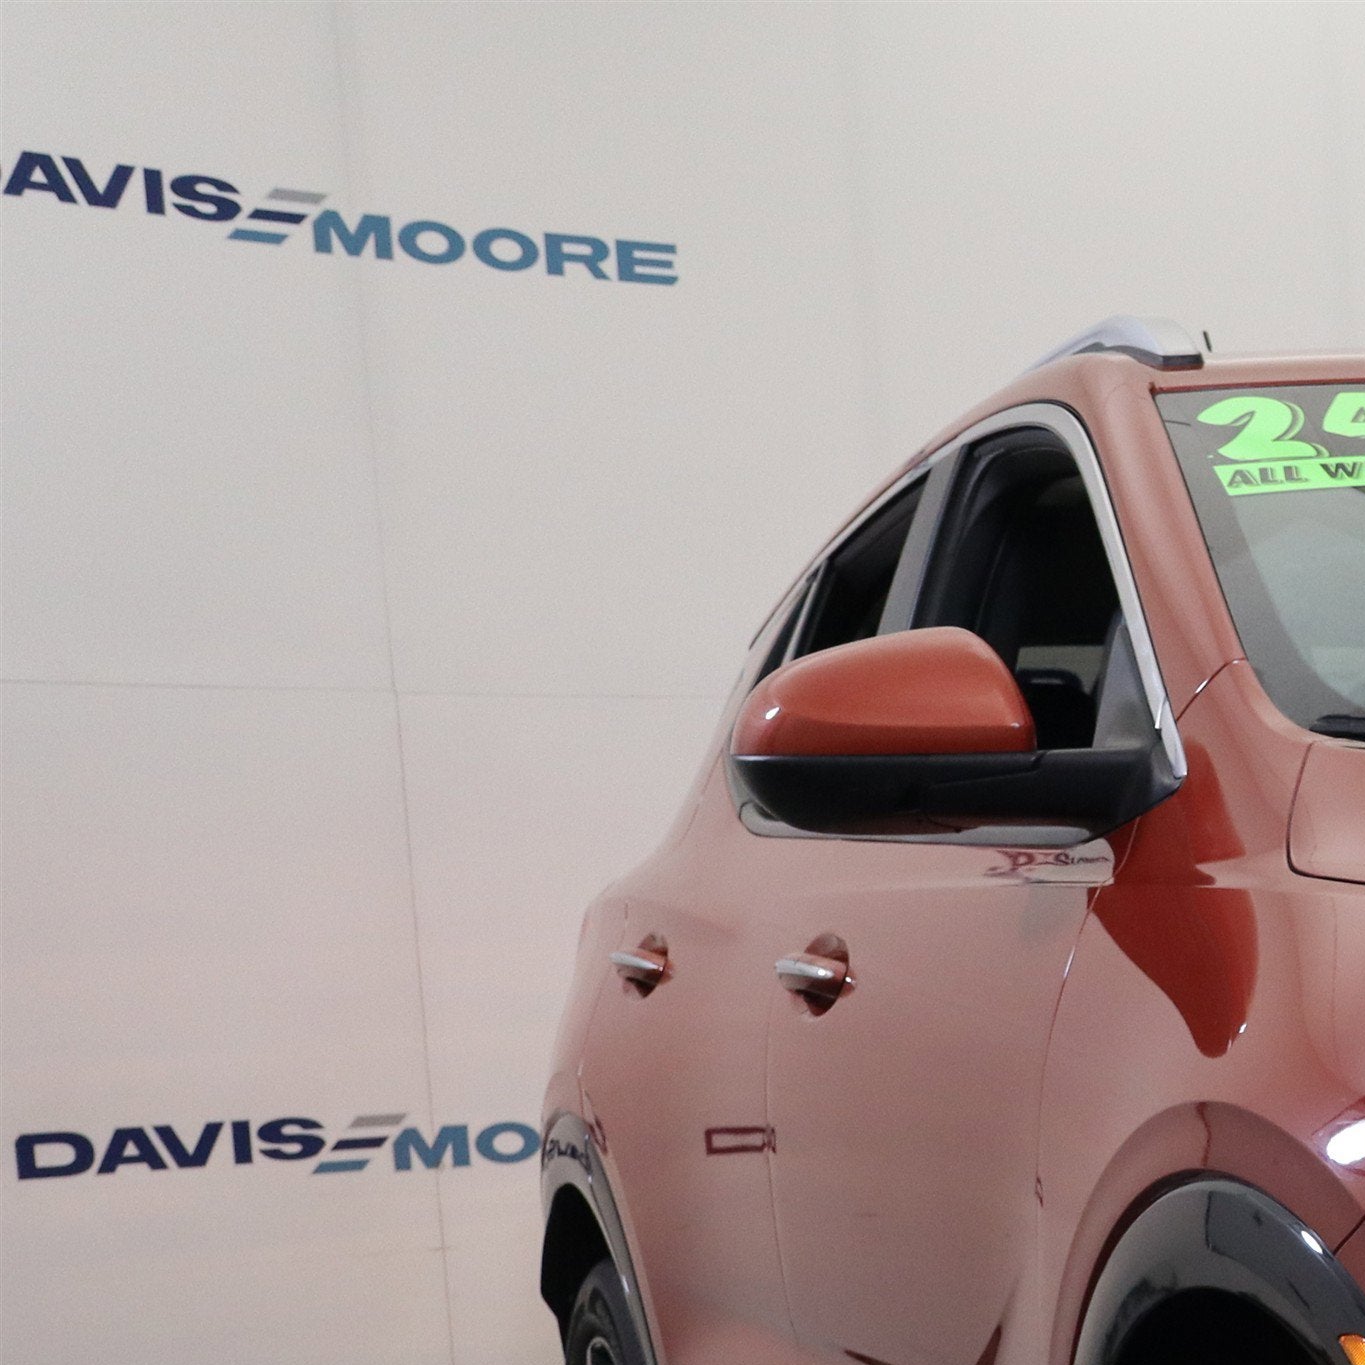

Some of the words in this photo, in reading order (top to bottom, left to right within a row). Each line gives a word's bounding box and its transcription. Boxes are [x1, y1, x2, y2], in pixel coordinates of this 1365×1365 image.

[0, 149, 243, 224] AVIS
[310, 208, 679, 287] MOORE
[1226, 464, 1310, 489] ALL
[13, 1116, 327, 1182] DAVIS
